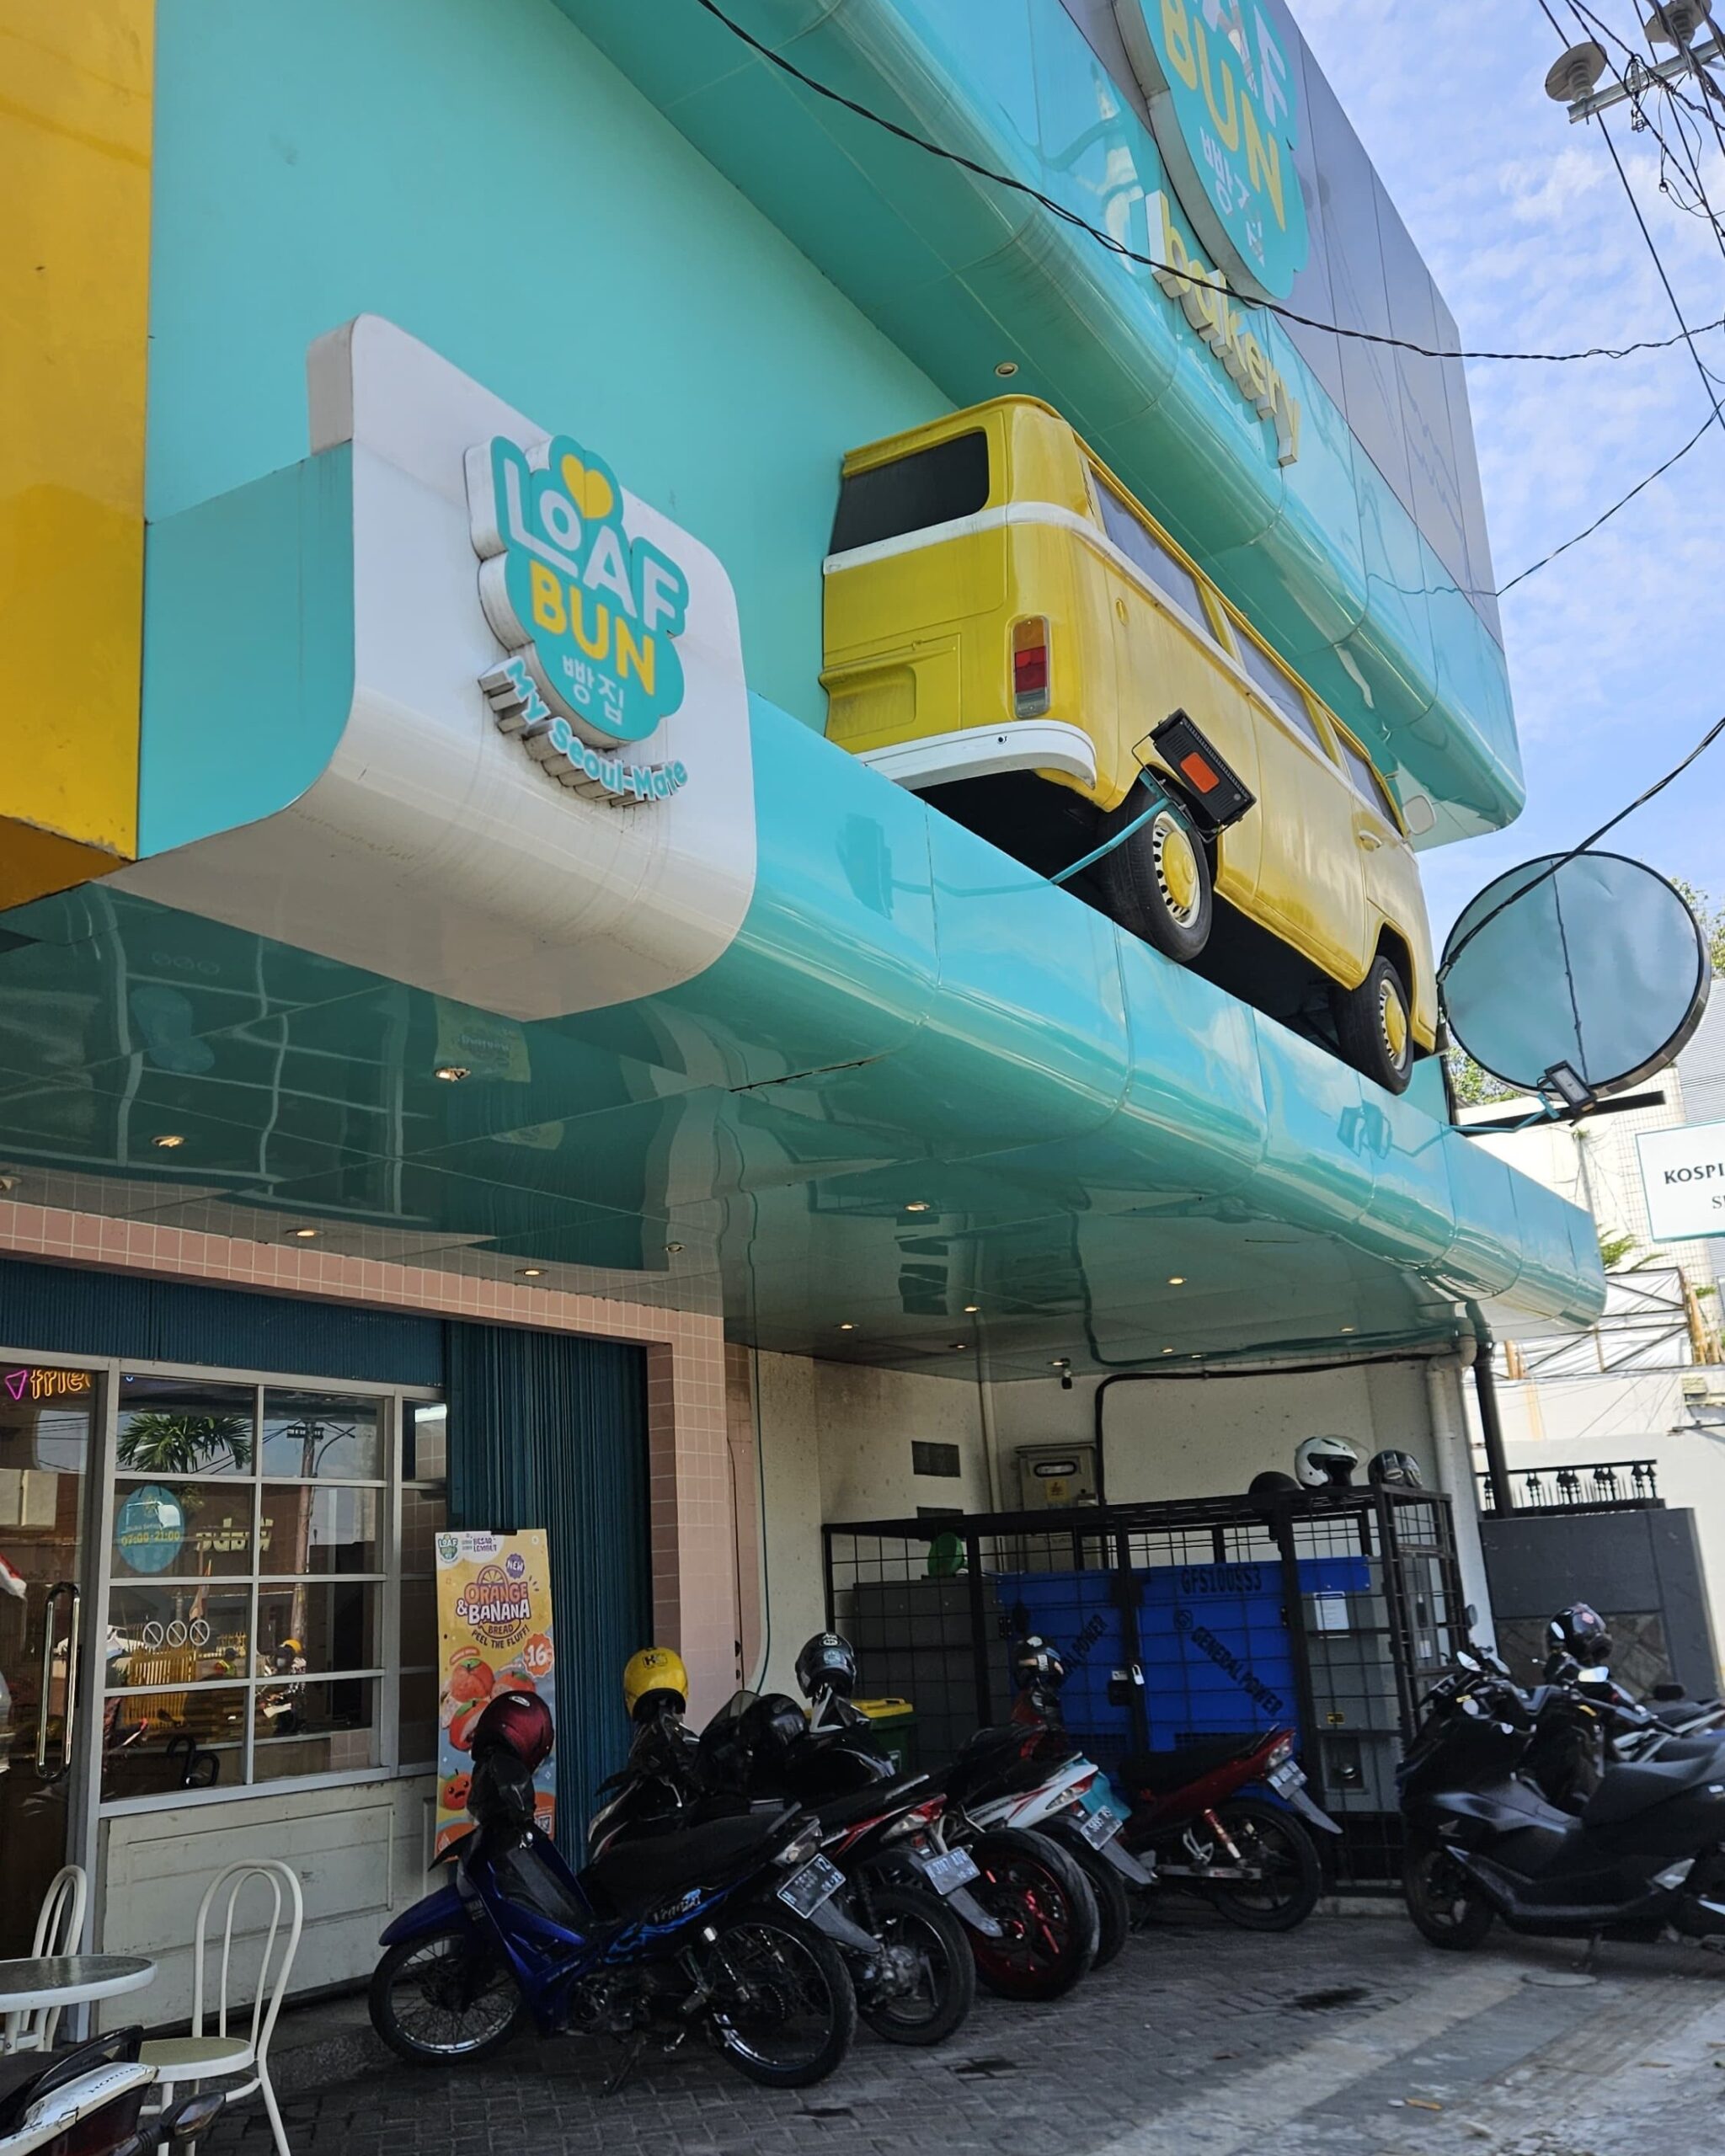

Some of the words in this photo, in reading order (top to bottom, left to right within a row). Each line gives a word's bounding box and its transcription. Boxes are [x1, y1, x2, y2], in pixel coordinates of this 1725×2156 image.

[1162, 0, 1285, 232] BUN
[1147, 189, 1301, 467] bakery
[503, 456, 680, 632] LOAF
[530, 559, 654, 696] BUN
[563, 654, 625, 726] 빵집
[505, 657, 551, 724] My
[549, 718, 688, 800] Seoul-Mate
[1664, 1162, 1724, 1185] KOSPI
[464, 1582, 529, 1604] ORANGE
[507, 1559, 524, 1572] NEW
[457, 1598, 467, 1616] &
[467, 1598, 531, 1625] BANANA
[471, 1629, 489, 1646] PEEL
[491, 1640, 505, 1649] THE
[507, 1625, 531, 1647] FLUFF!
[488, 1624, 514, 1635] BREAD
[1191, 1626, 1245, 1684] GENERAL
[1242, 1671, 1284, 1717] POWER
